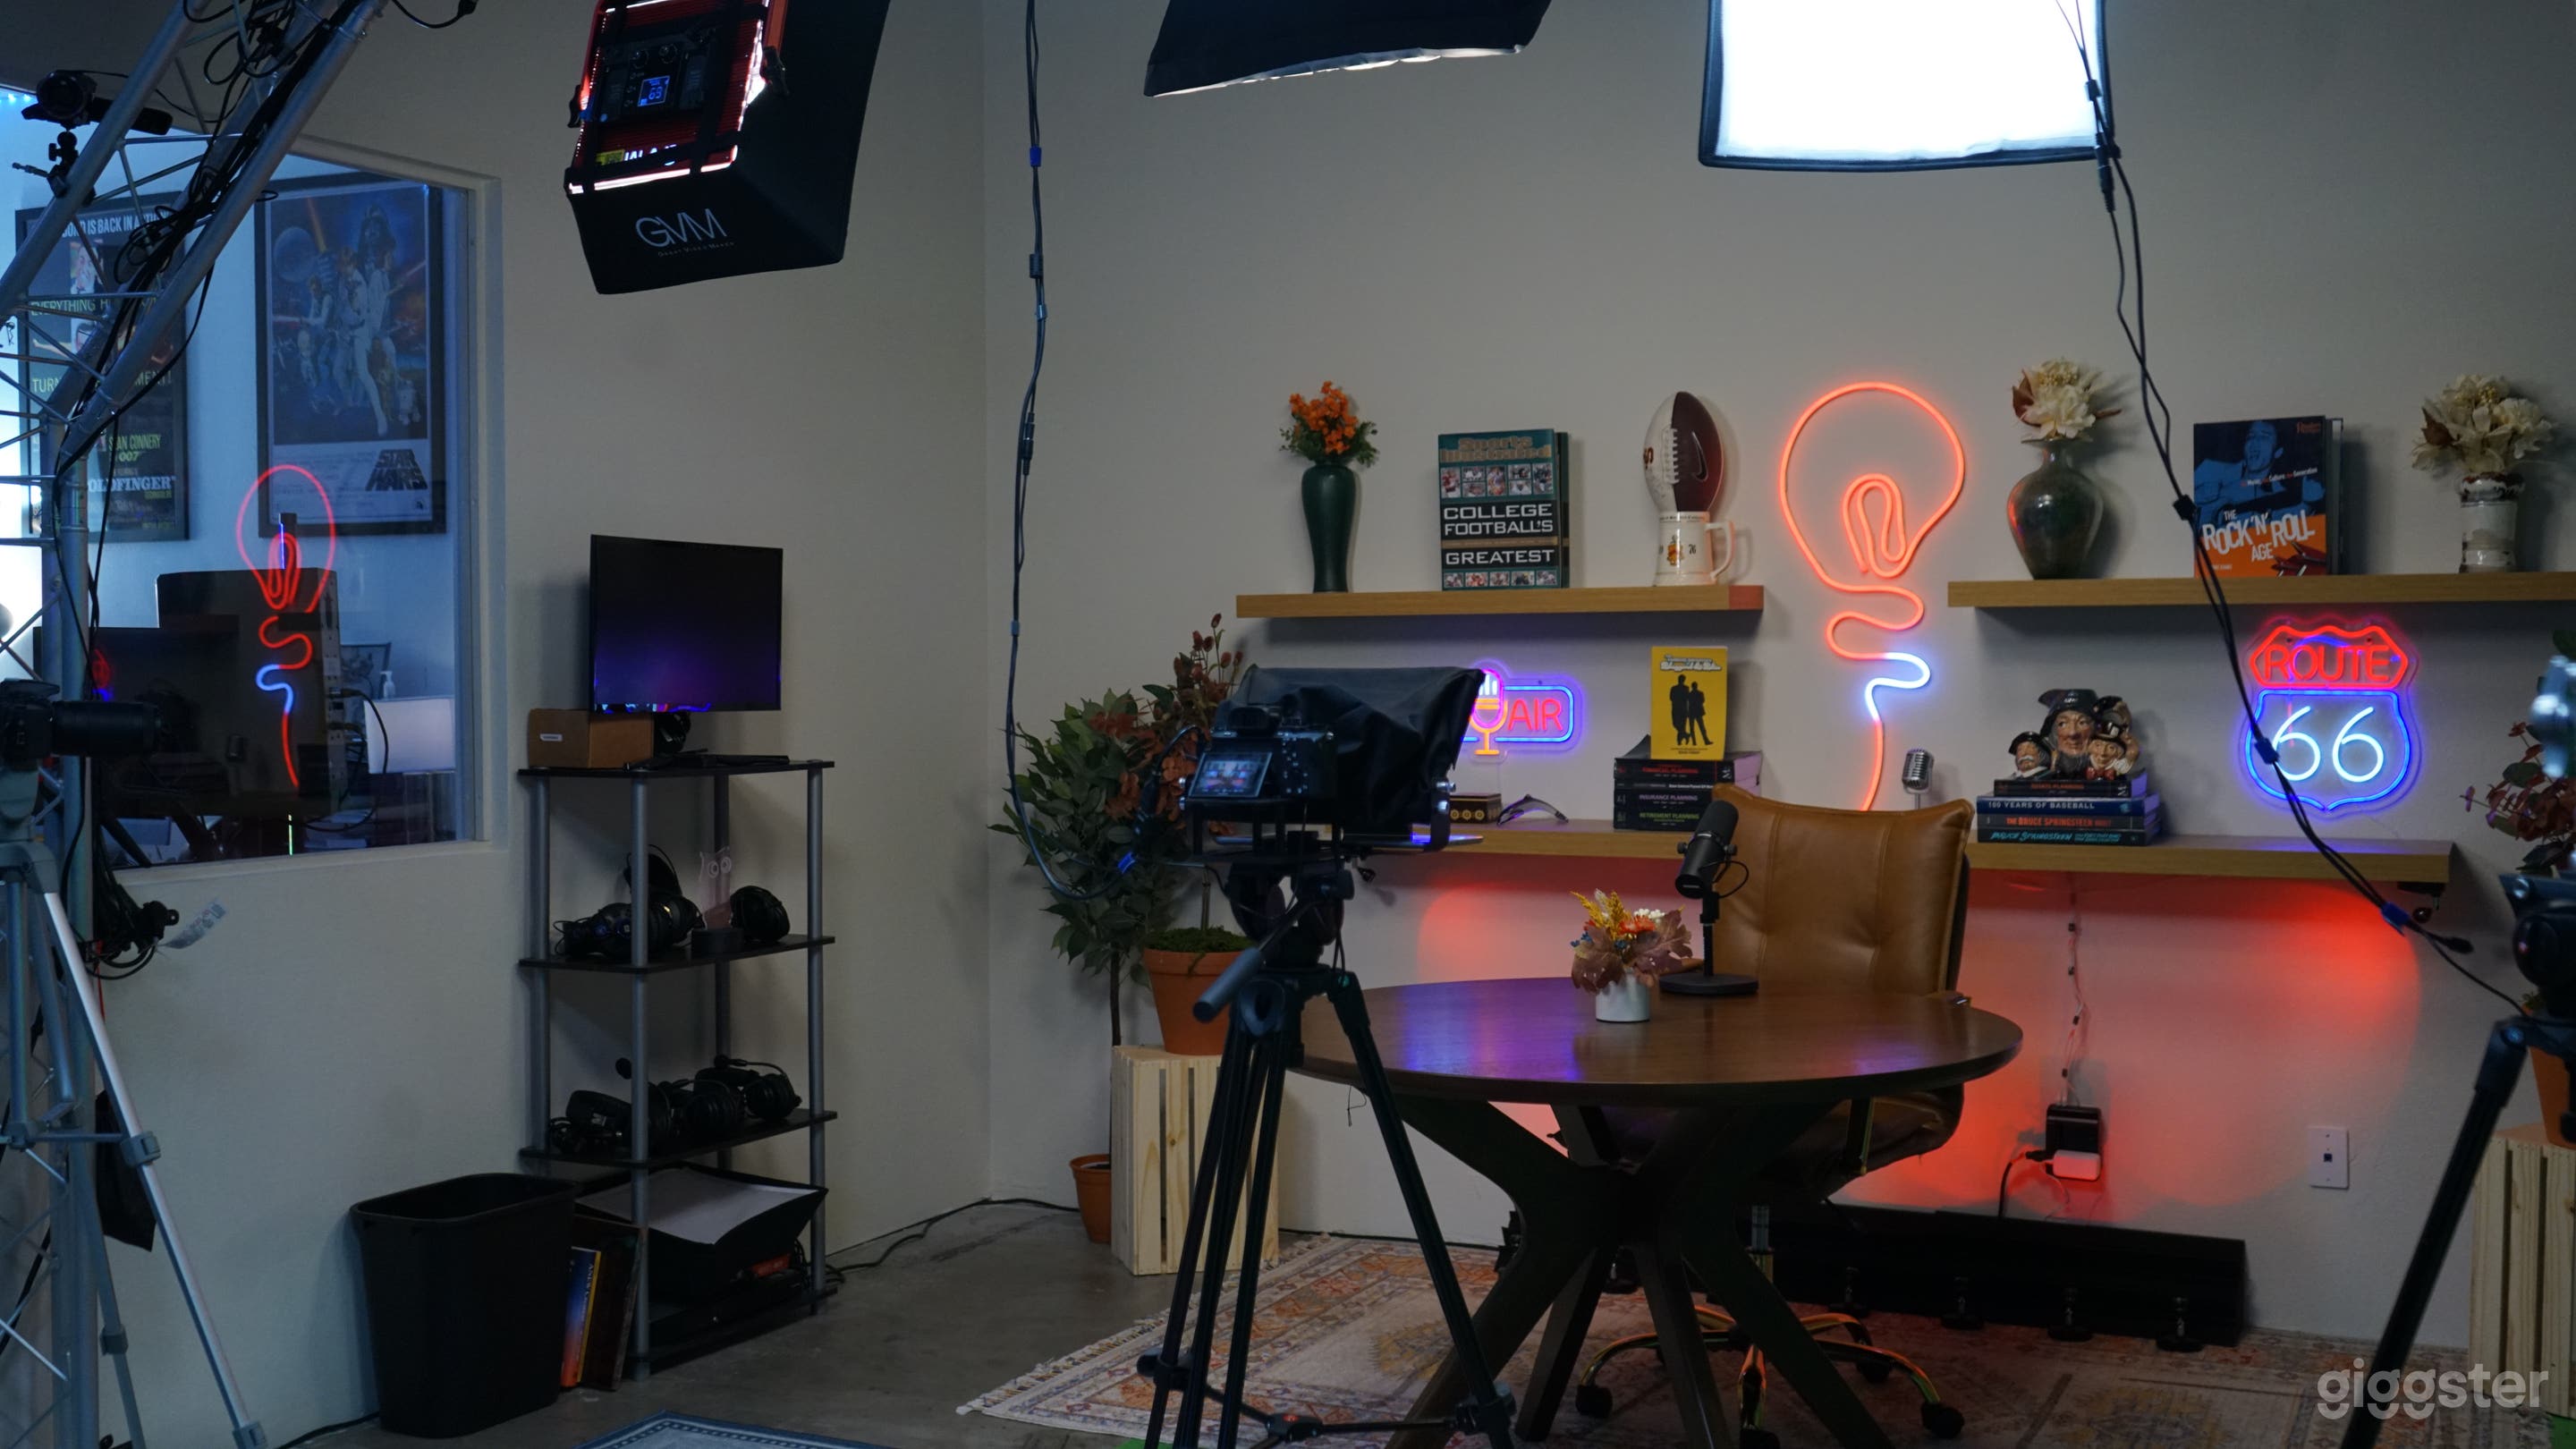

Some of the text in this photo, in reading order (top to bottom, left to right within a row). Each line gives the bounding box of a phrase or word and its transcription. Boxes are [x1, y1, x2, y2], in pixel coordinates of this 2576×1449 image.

[87, 220, 97, 235] IS
[97, 216, 123, 234] BACK
[123, 216, 132, 232] IN
[635, 208, 727, 248] GVM
[108, 435, 127, 452] SAN
[119, 451, 140, 462] 007
[1444, 504, 1553, 520] COLLEGE
[2224, 509, 2237, 521] THE
[1445, 520, 1554, 536] FOOTBALL'S
[2202, 519, 2253, 555] ROCK
[2270, 509, 2316, 548] ROLL
[1445, 549, 1555, 565] GREATEST
[2251, 542, 2275, 563] AGE
[2264, 644, 2390, 681] ROUTE
[1507, 698, 1563, 732] AIR
[2272, 705, 2385, 784] 66
[1670, 794, 1699, 802] PLANNING
[1988, 801, 2096, 809] 100 YEARS OF BASEBALL
[2018, 817, 2042, 826] BRUCE
[2044, 818, 2093, 826] SPRINGSTEEN
